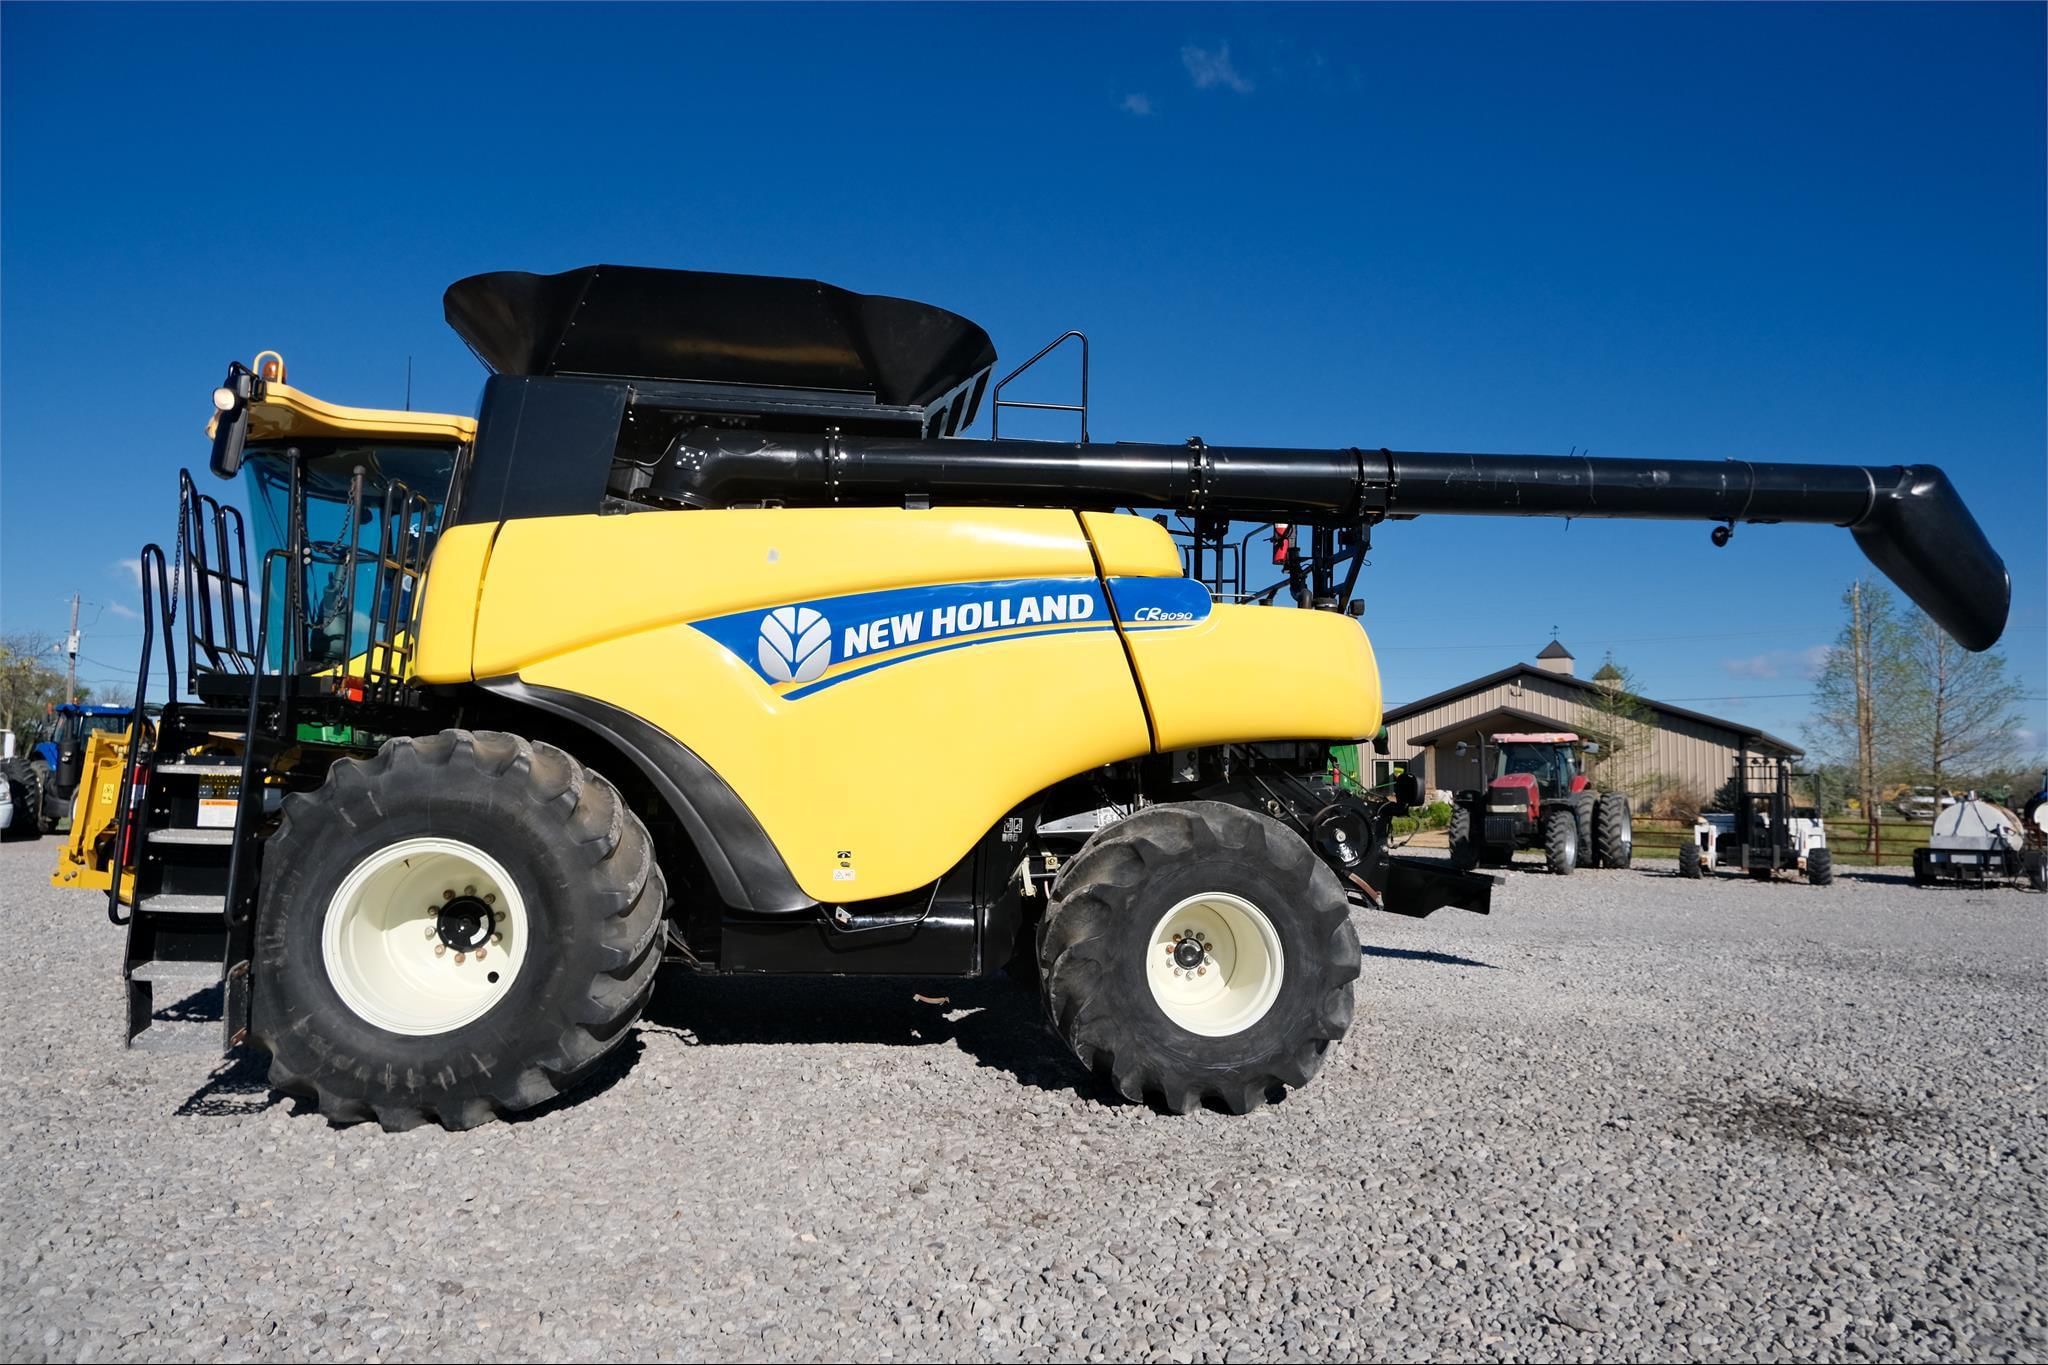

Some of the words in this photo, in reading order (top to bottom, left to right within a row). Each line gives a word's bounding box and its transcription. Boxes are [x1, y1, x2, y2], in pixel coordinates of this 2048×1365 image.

[843, 611, 923, 658] NEW
[931, 594, 1094, 637] HOLLAND
[1134, 607, 1193, 621] CR8090
